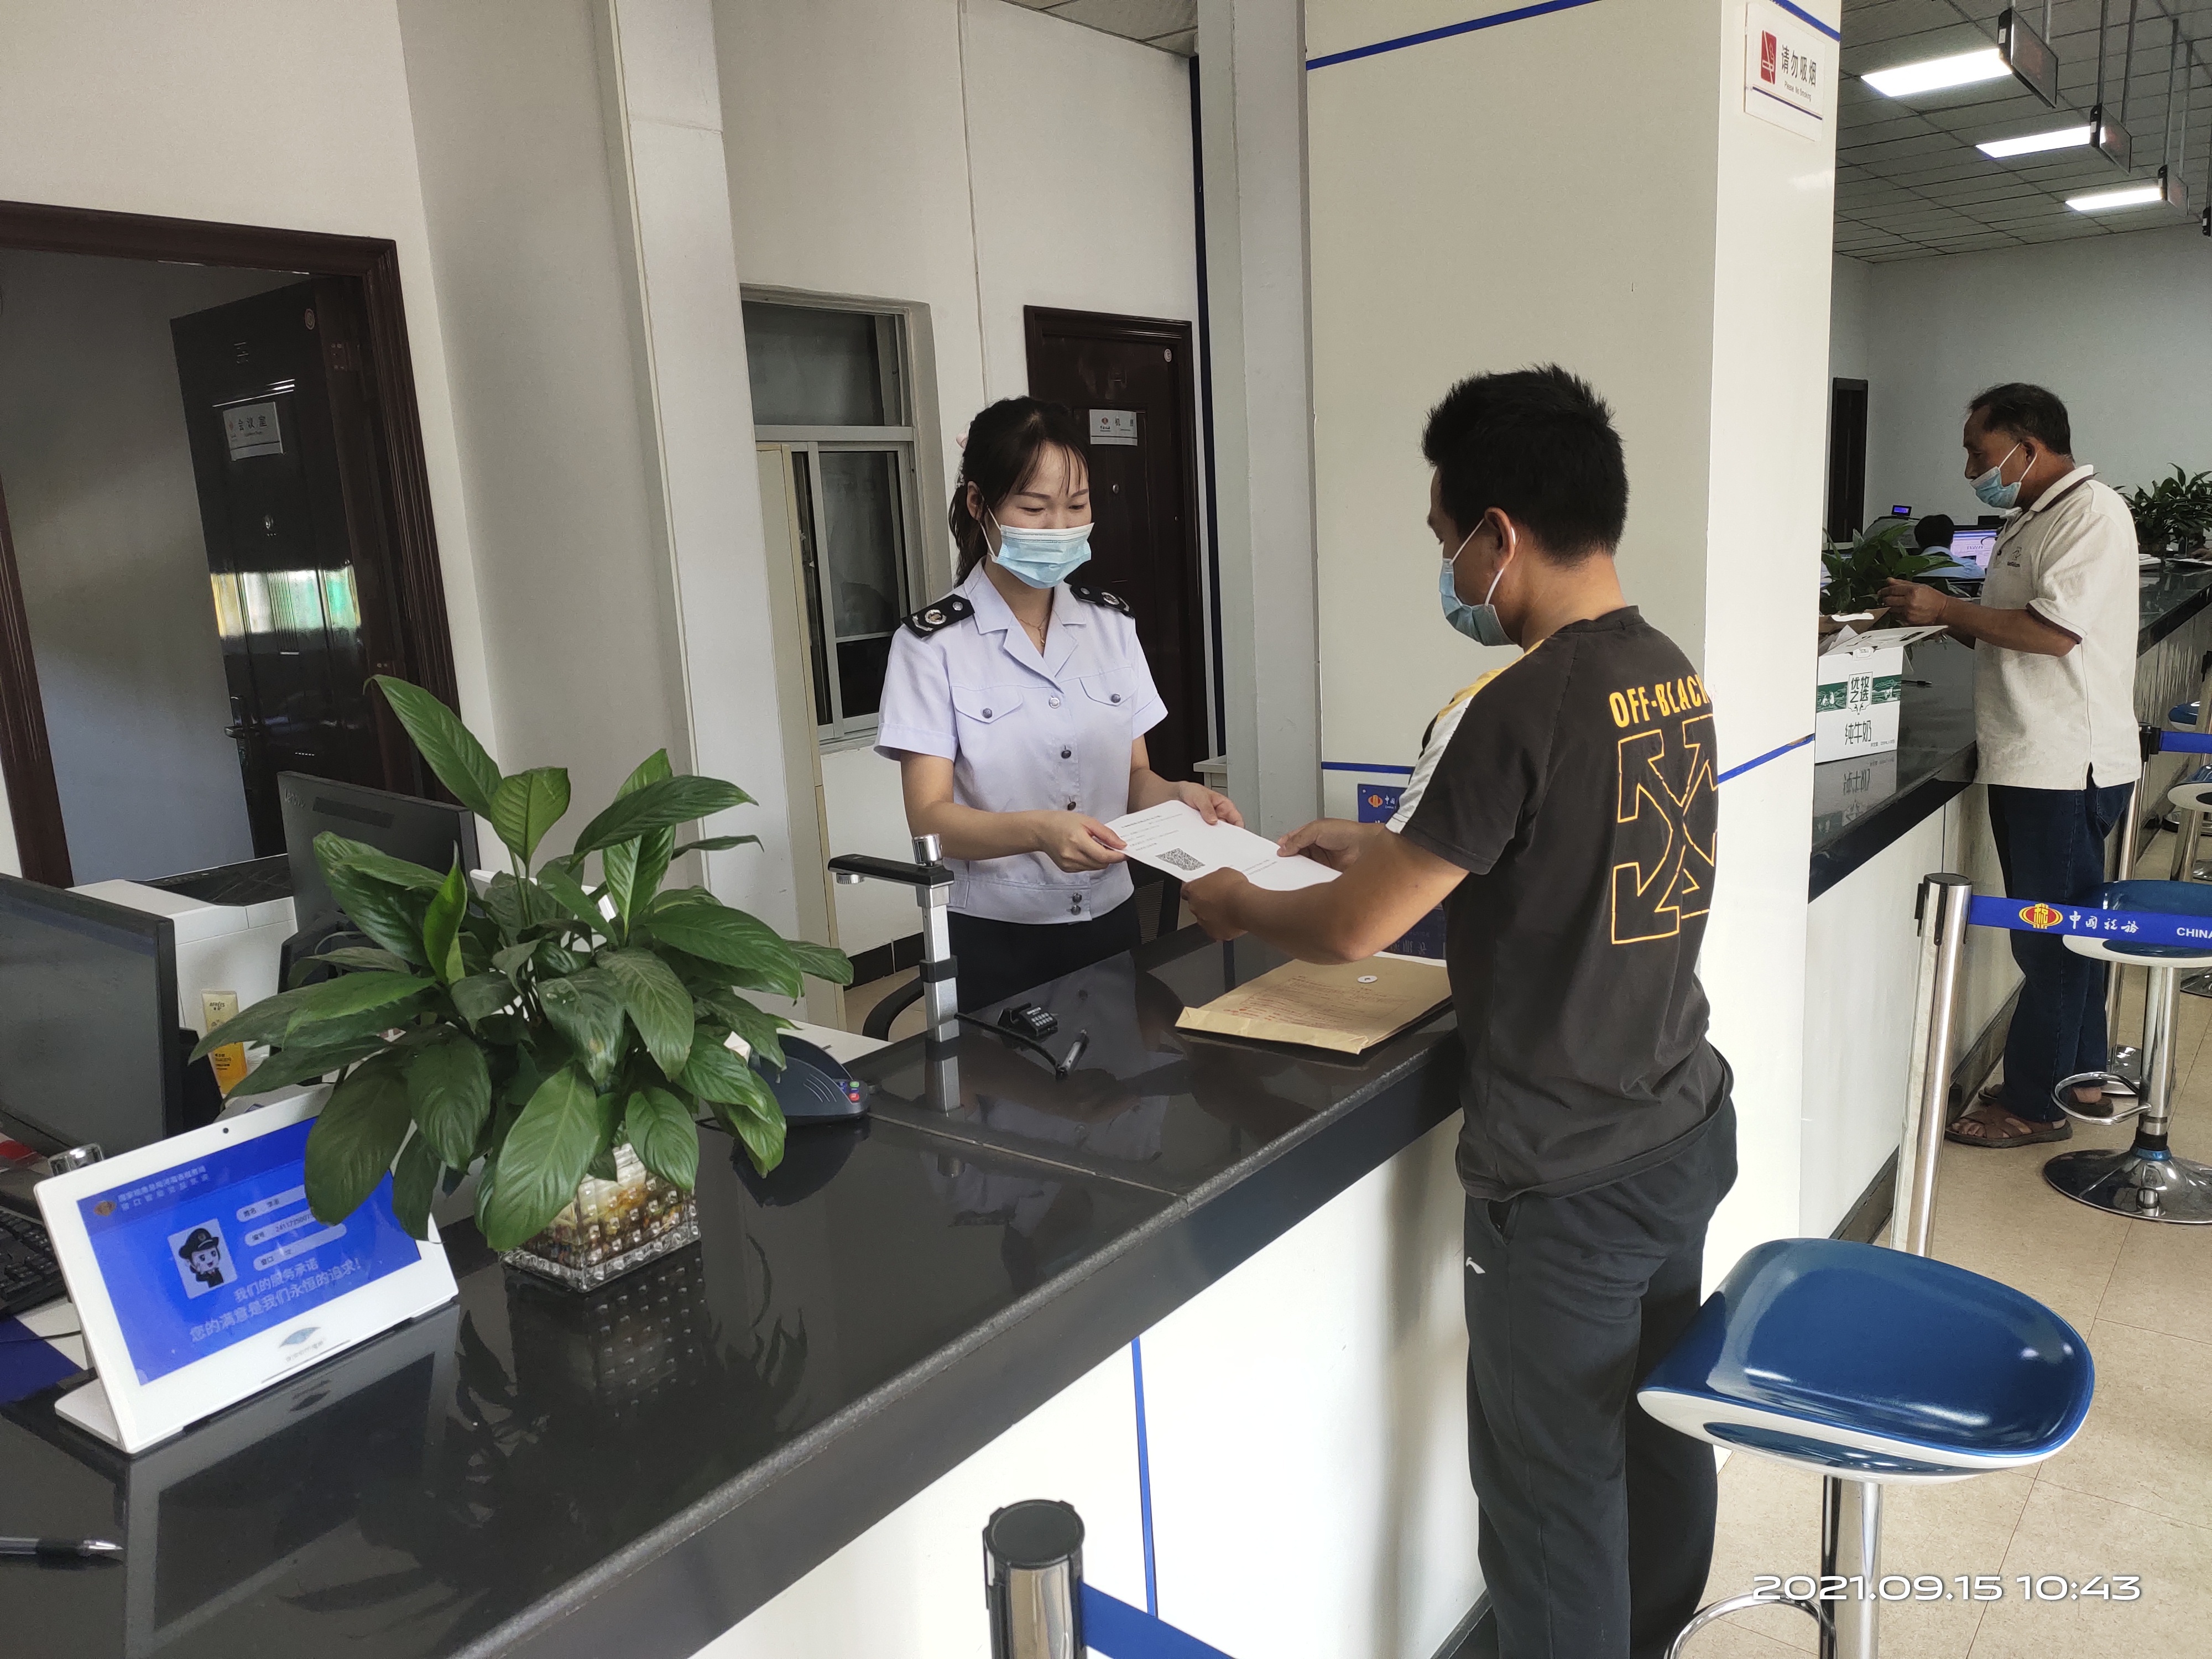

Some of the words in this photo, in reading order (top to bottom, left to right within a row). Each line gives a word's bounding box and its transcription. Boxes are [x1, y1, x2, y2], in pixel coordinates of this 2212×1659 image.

[1781, 44, 1817, 88] 请勿吸烟
[1784, 80, 1794, 92] Please
[1795, 86, 1799, 95] No
[1799, 88, 1812, 102] Smoking
[238, 415, 267, 431] 会议室
[1844, 720, 1872, 745] 纯牛奶
[234, 1257, 319, 1302] 我们的服务承诺
